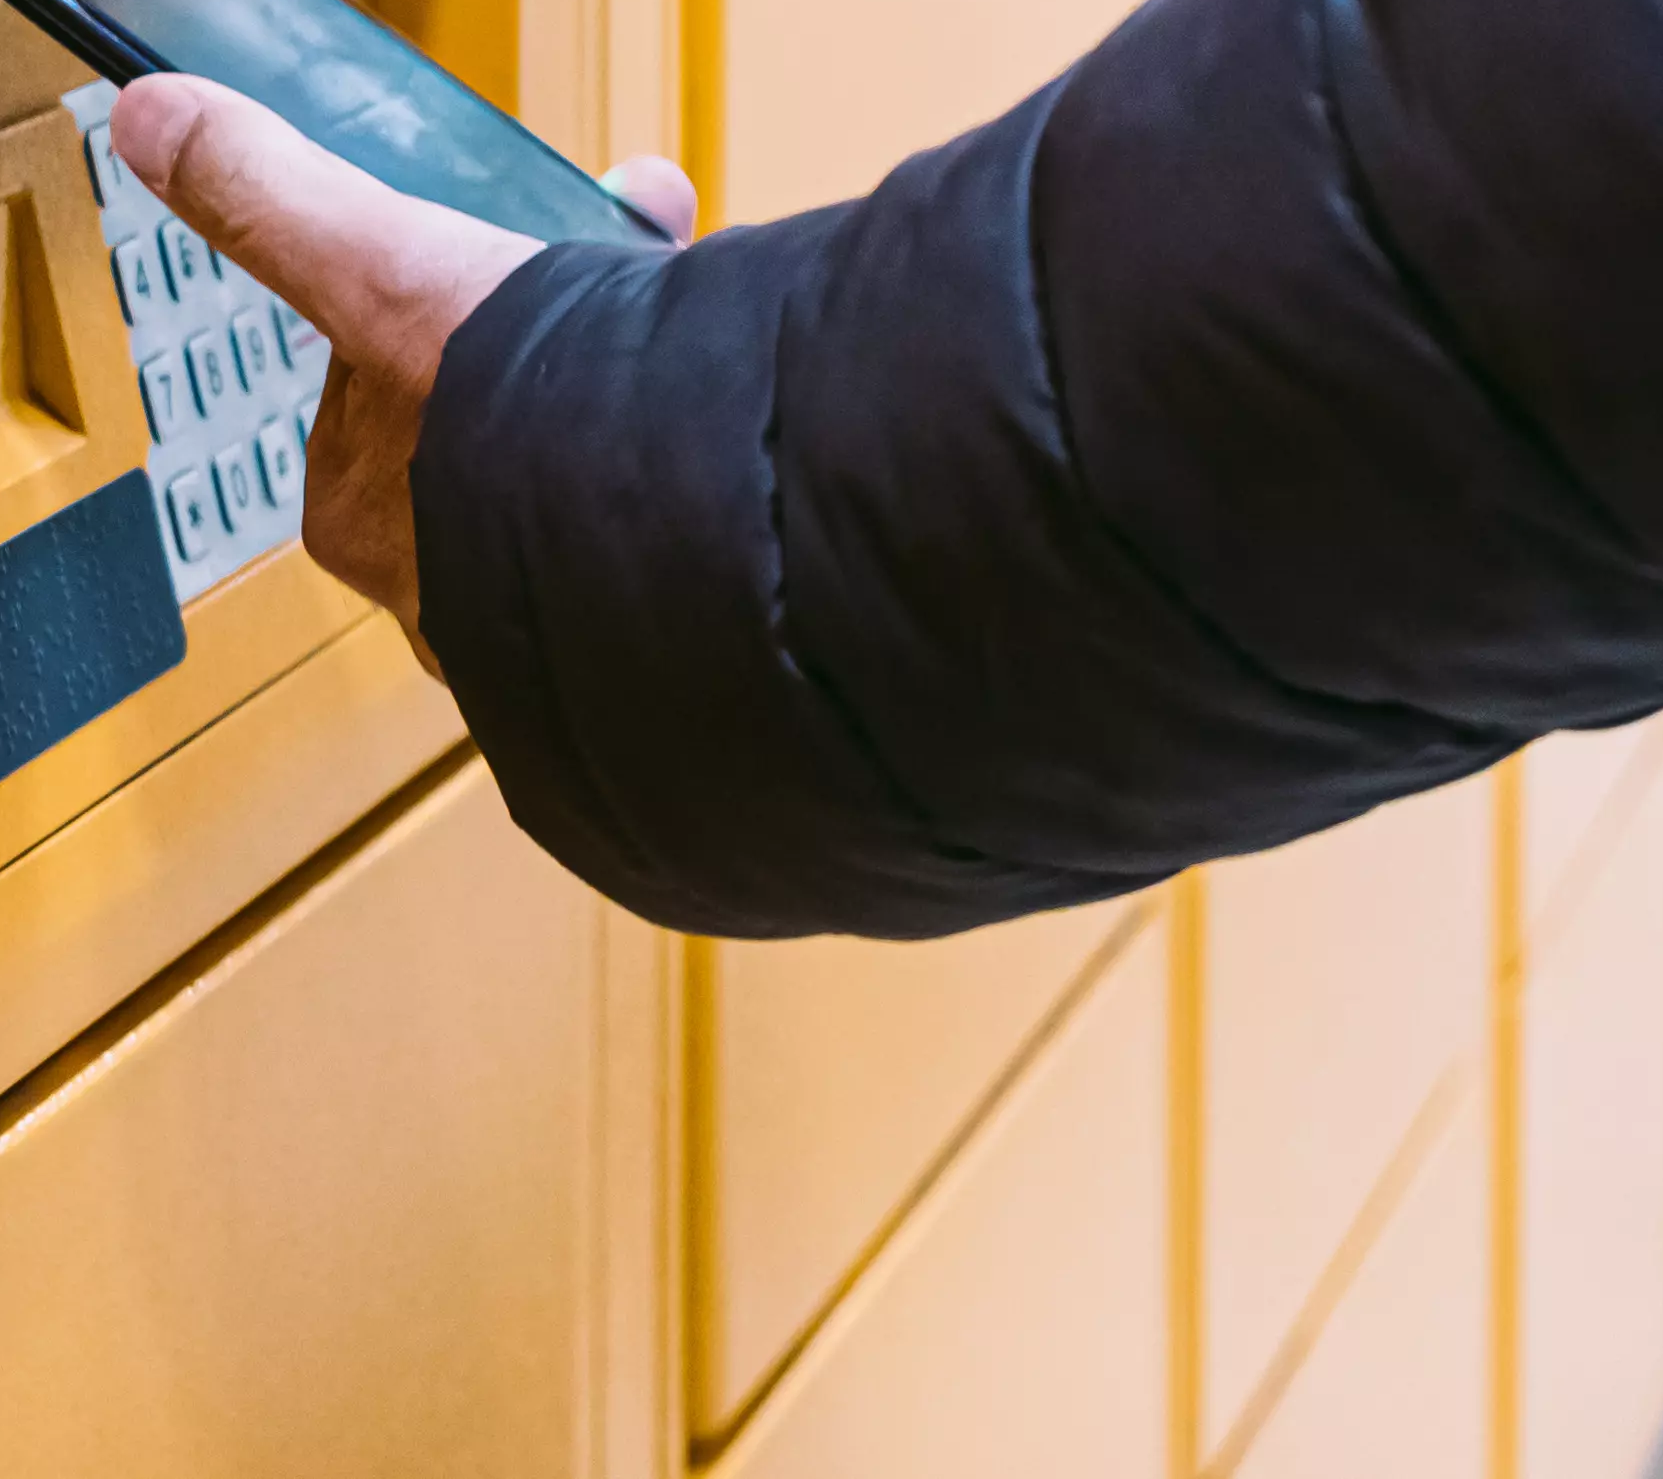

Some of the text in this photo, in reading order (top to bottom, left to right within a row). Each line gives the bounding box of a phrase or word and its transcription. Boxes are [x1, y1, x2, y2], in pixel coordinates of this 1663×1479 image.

[137, 255, 151, 299] 4
[158, 326, 266, 421] 7 8 9
[230, 462, 248, 508] 0
